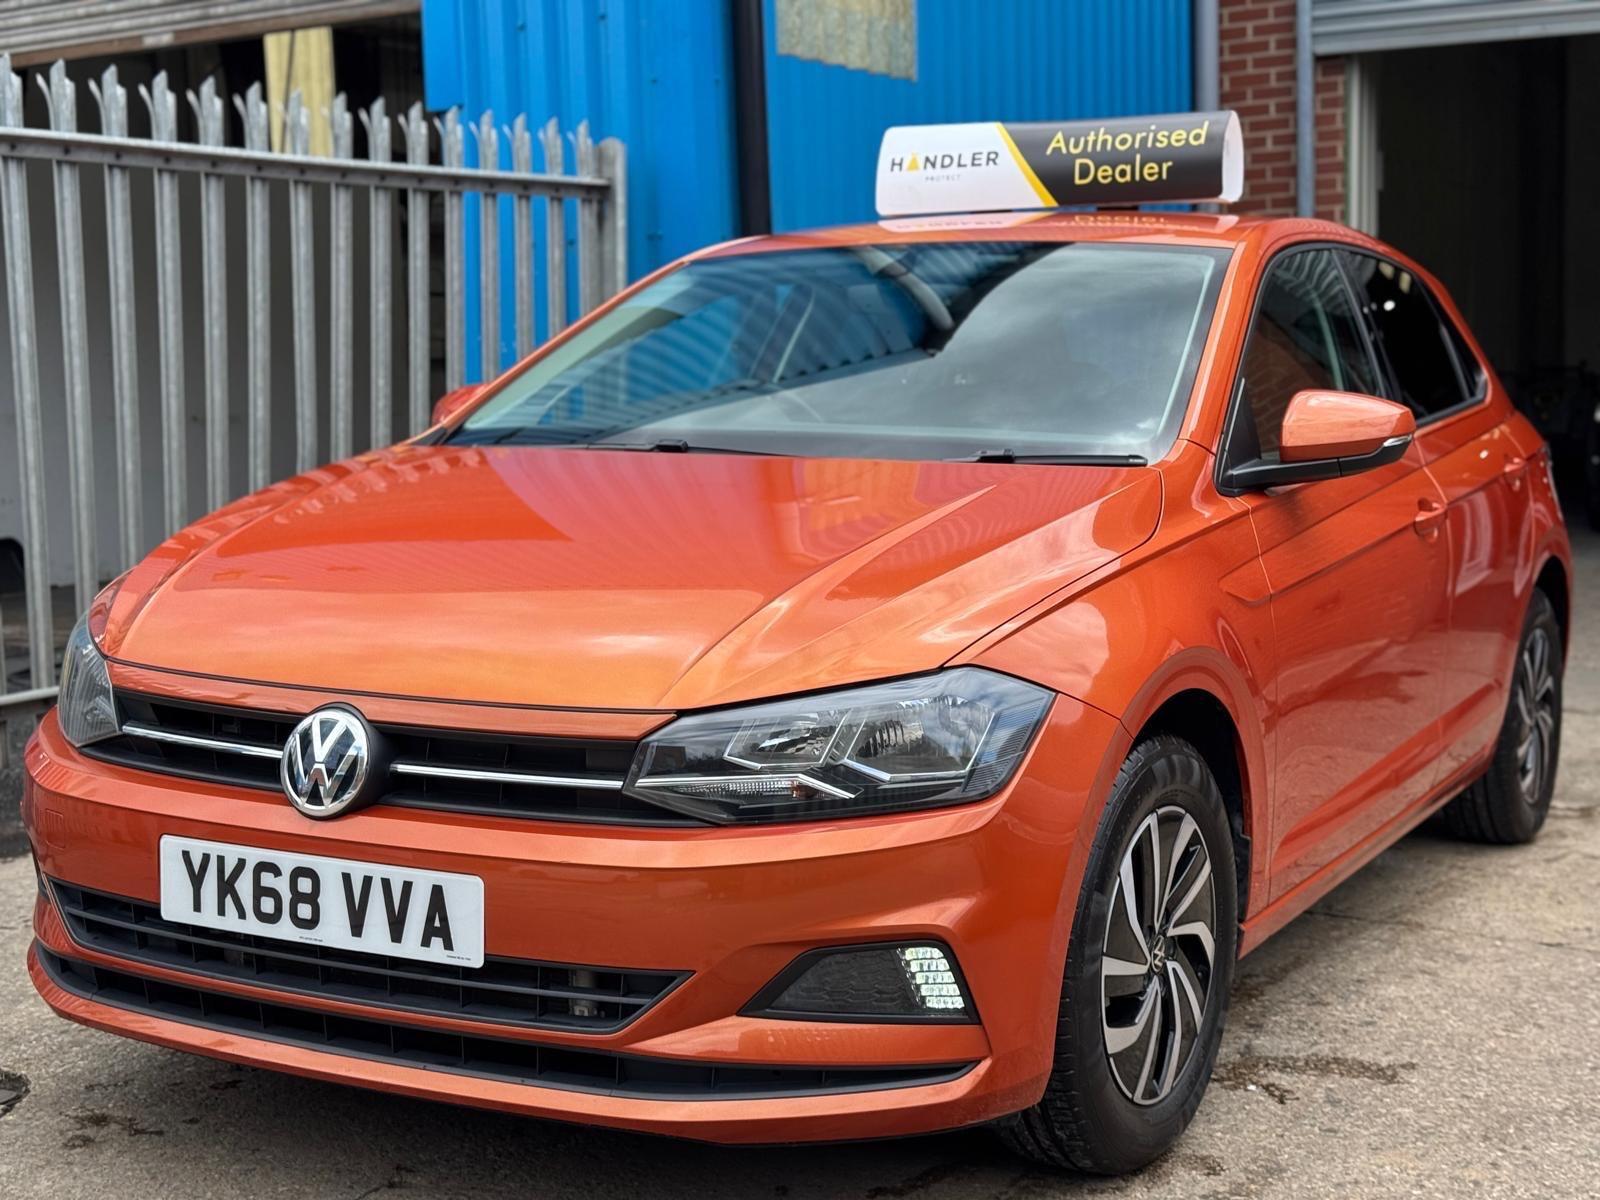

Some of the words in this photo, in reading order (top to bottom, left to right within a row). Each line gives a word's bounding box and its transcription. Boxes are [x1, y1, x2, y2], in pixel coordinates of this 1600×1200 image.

[1046, 120, 1209, 155] Authorised
[1074, 153, 1173, 185] Dealer
[181, 850, 321, 930] YK68
[341, 872, 454, 951] VVA
